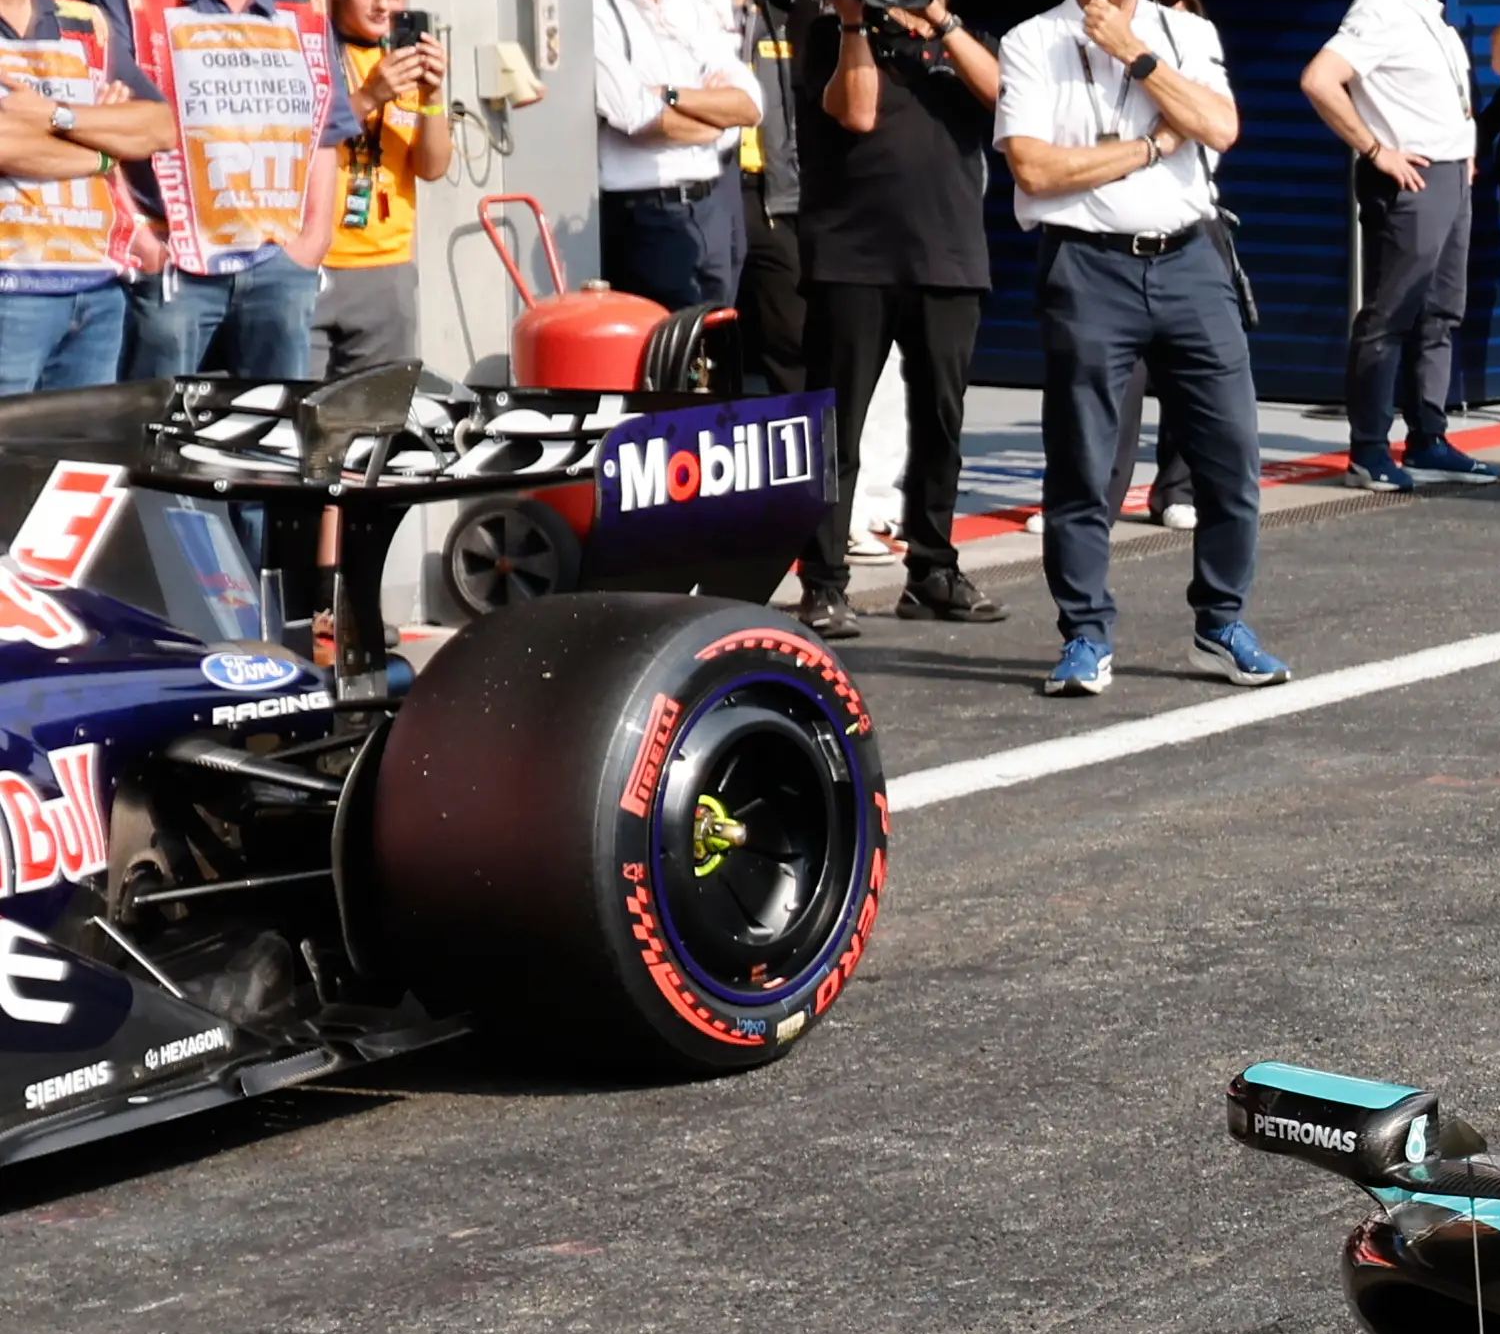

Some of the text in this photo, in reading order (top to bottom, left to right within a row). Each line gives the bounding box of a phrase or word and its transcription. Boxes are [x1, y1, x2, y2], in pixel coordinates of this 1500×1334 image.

[188, 78, 307, 97] SCRUTINEER
[215, 99, 311, 116] PLATFORM
[618, 436, 764, 515] Mobil
[213, 692, 331, 726] RACING
[621, 693, 683, 818] PIRELLI
[4, 743, 109, 894] Bull
[160, 1026, 224, 1066] HEXAGON
[25, 1059, 113, 1110] SIEMENS
[1252, 1110, 1357, 1155] PETRONAS
